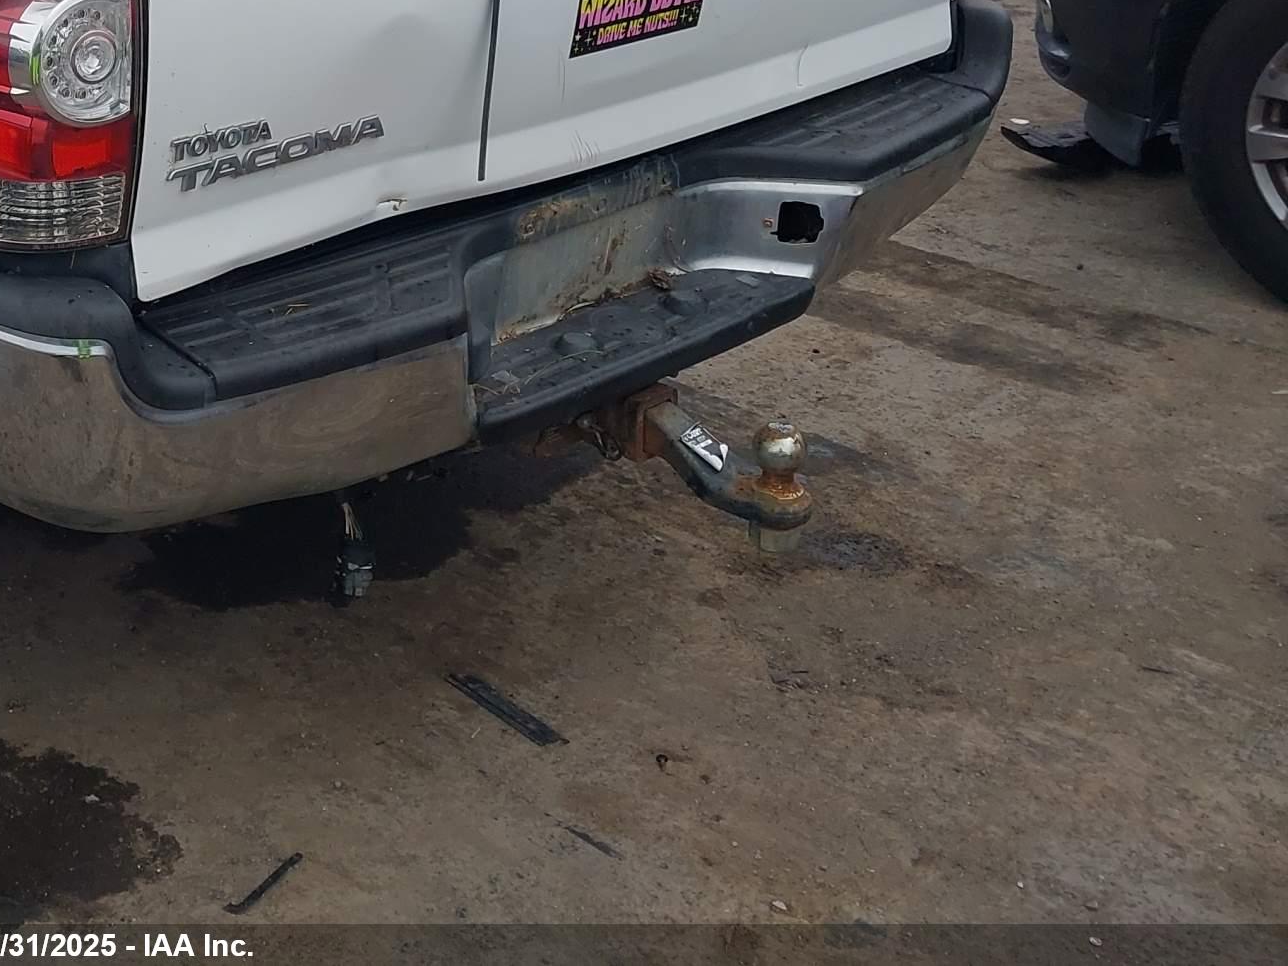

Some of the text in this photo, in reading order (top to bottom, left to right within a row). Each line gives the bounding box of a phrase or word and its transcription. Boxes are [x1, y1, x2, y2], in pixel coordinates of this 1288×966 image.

[596, 8, 680, 46] DRIVE ME NUTS!!!
[165, 113, 385, 193] TACOMA
[169, 118, 273, 164] TOYOTA
